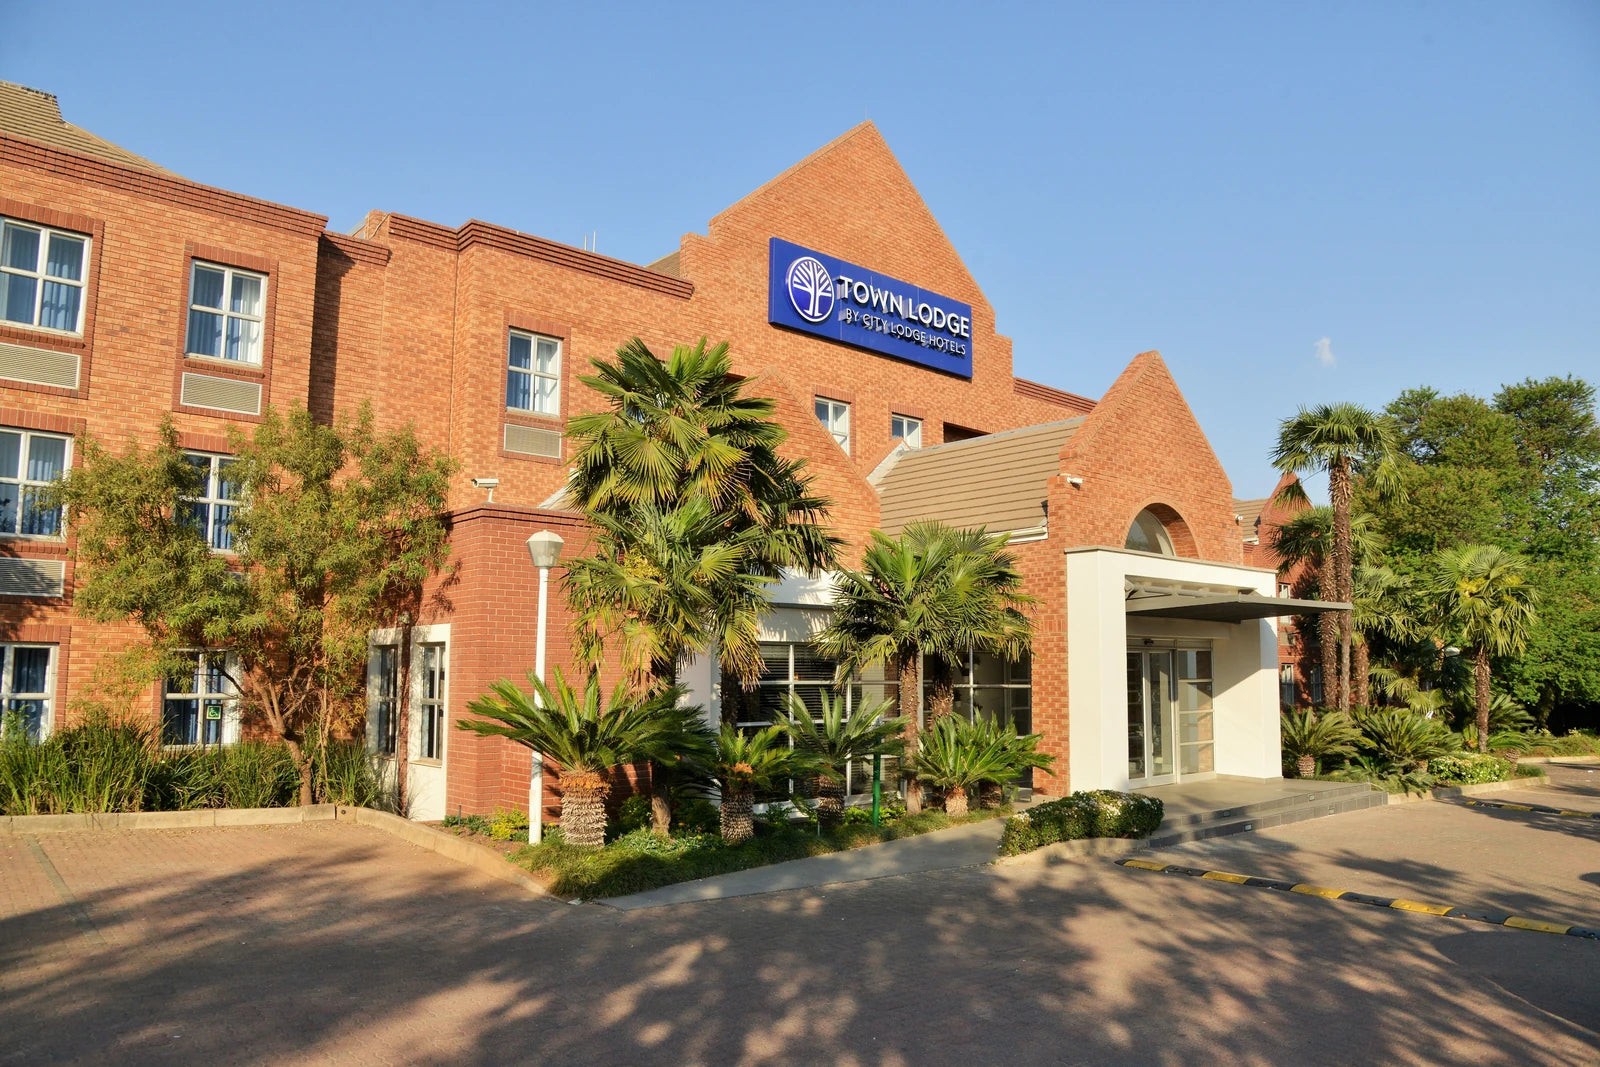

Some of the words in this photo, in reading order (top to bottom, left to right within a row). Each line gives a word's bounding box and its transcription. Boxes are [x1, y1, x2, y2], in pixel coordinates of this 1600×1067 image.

[837, 275, 903, 316] TOWN
[908, 298, 970, 338] LODGE
[846, 308, 859, 321] BY
[863, 313, 888, 330] CITY
[890, 322, 926, 343] LODGE
[929, 333, 966, 355] HOTELS
